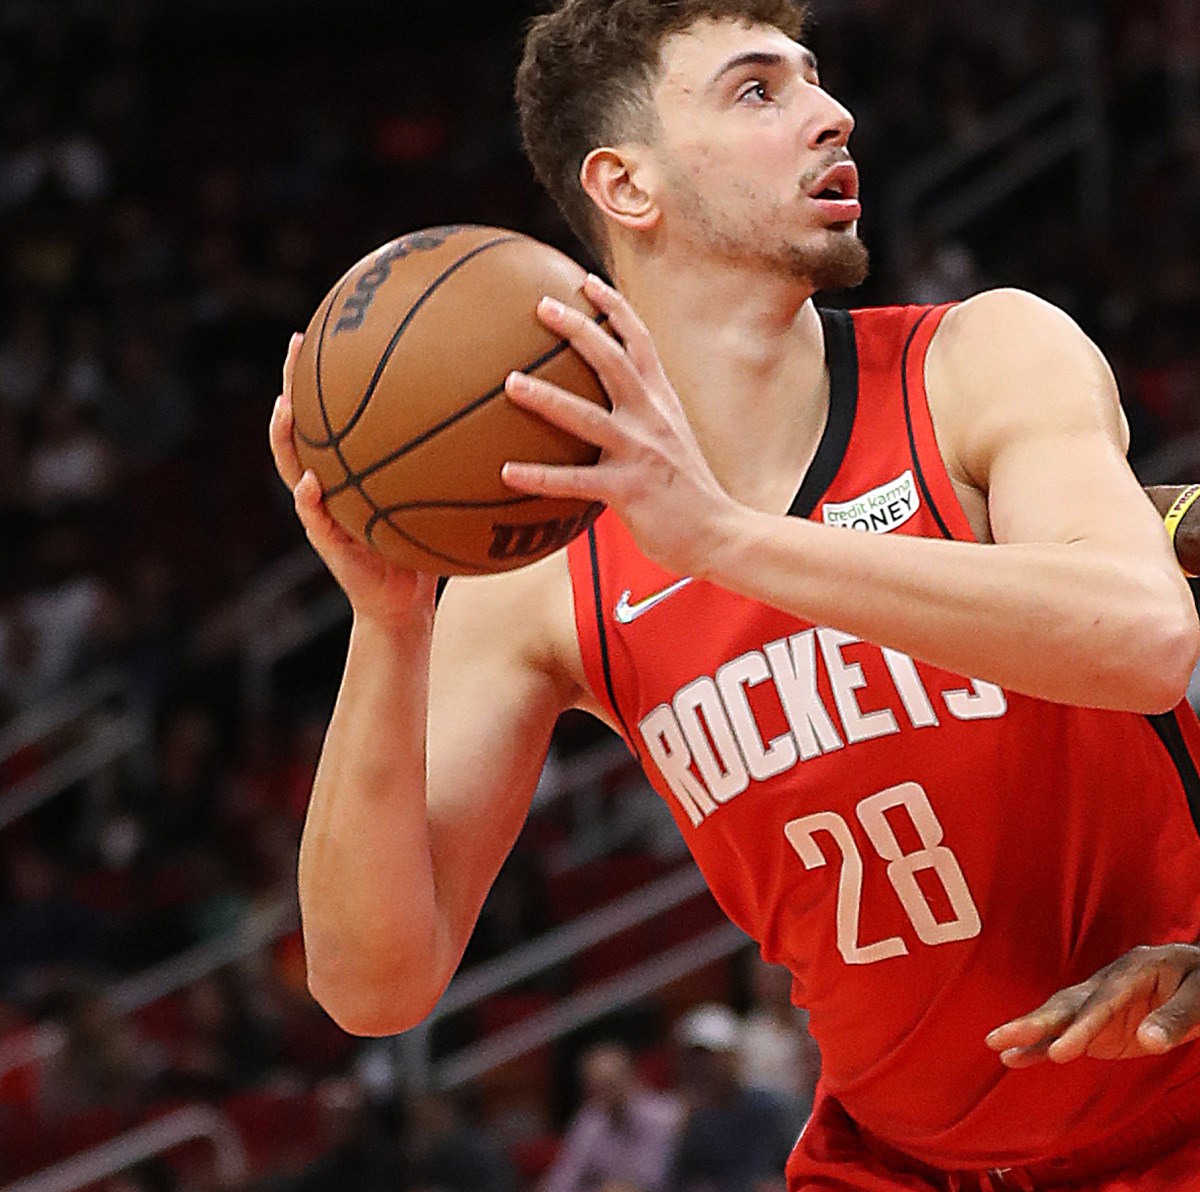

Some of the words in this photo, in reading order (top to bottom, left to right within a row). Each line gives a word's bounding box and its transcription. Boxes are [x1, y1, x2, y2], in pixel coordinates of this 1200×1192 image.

[827, 502, 866, 522] credit
[868, 479, 911, 508] karma
[830, 490, 912, 532] ONEY
[784, 781, 983, 966] 28
